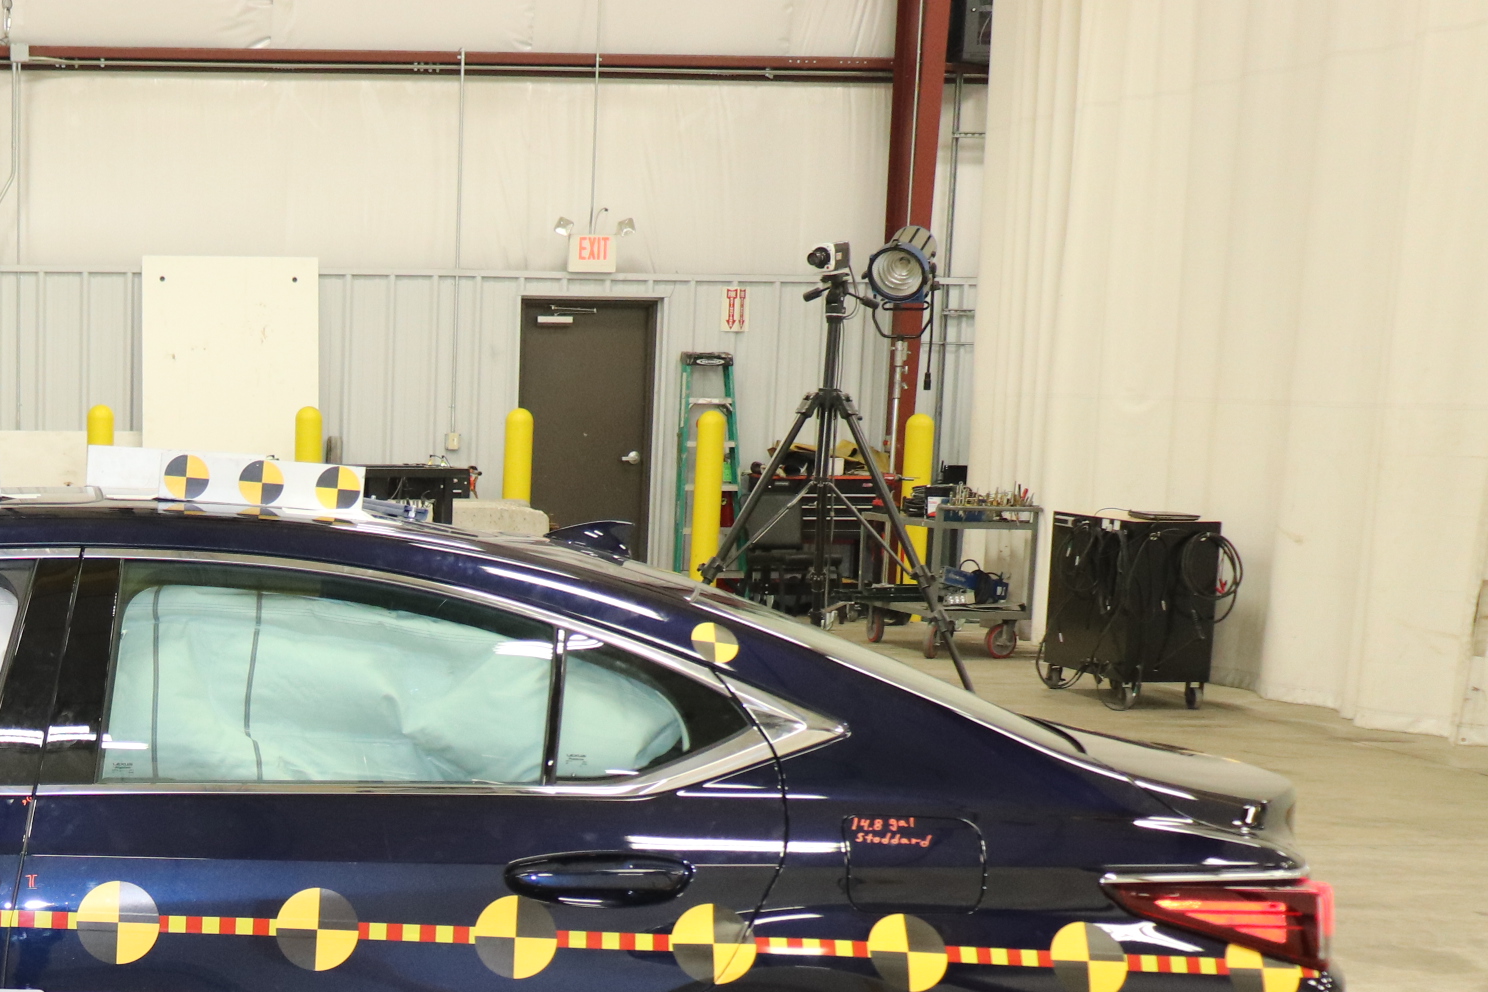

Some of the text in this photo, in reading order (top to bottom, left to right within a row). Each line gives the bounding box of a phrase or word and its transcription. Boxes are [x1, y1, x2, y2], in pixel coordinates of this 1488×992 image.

[578, 236, 610, 260] EXIT
[851, 817, 915, 832] 14.8 gal
